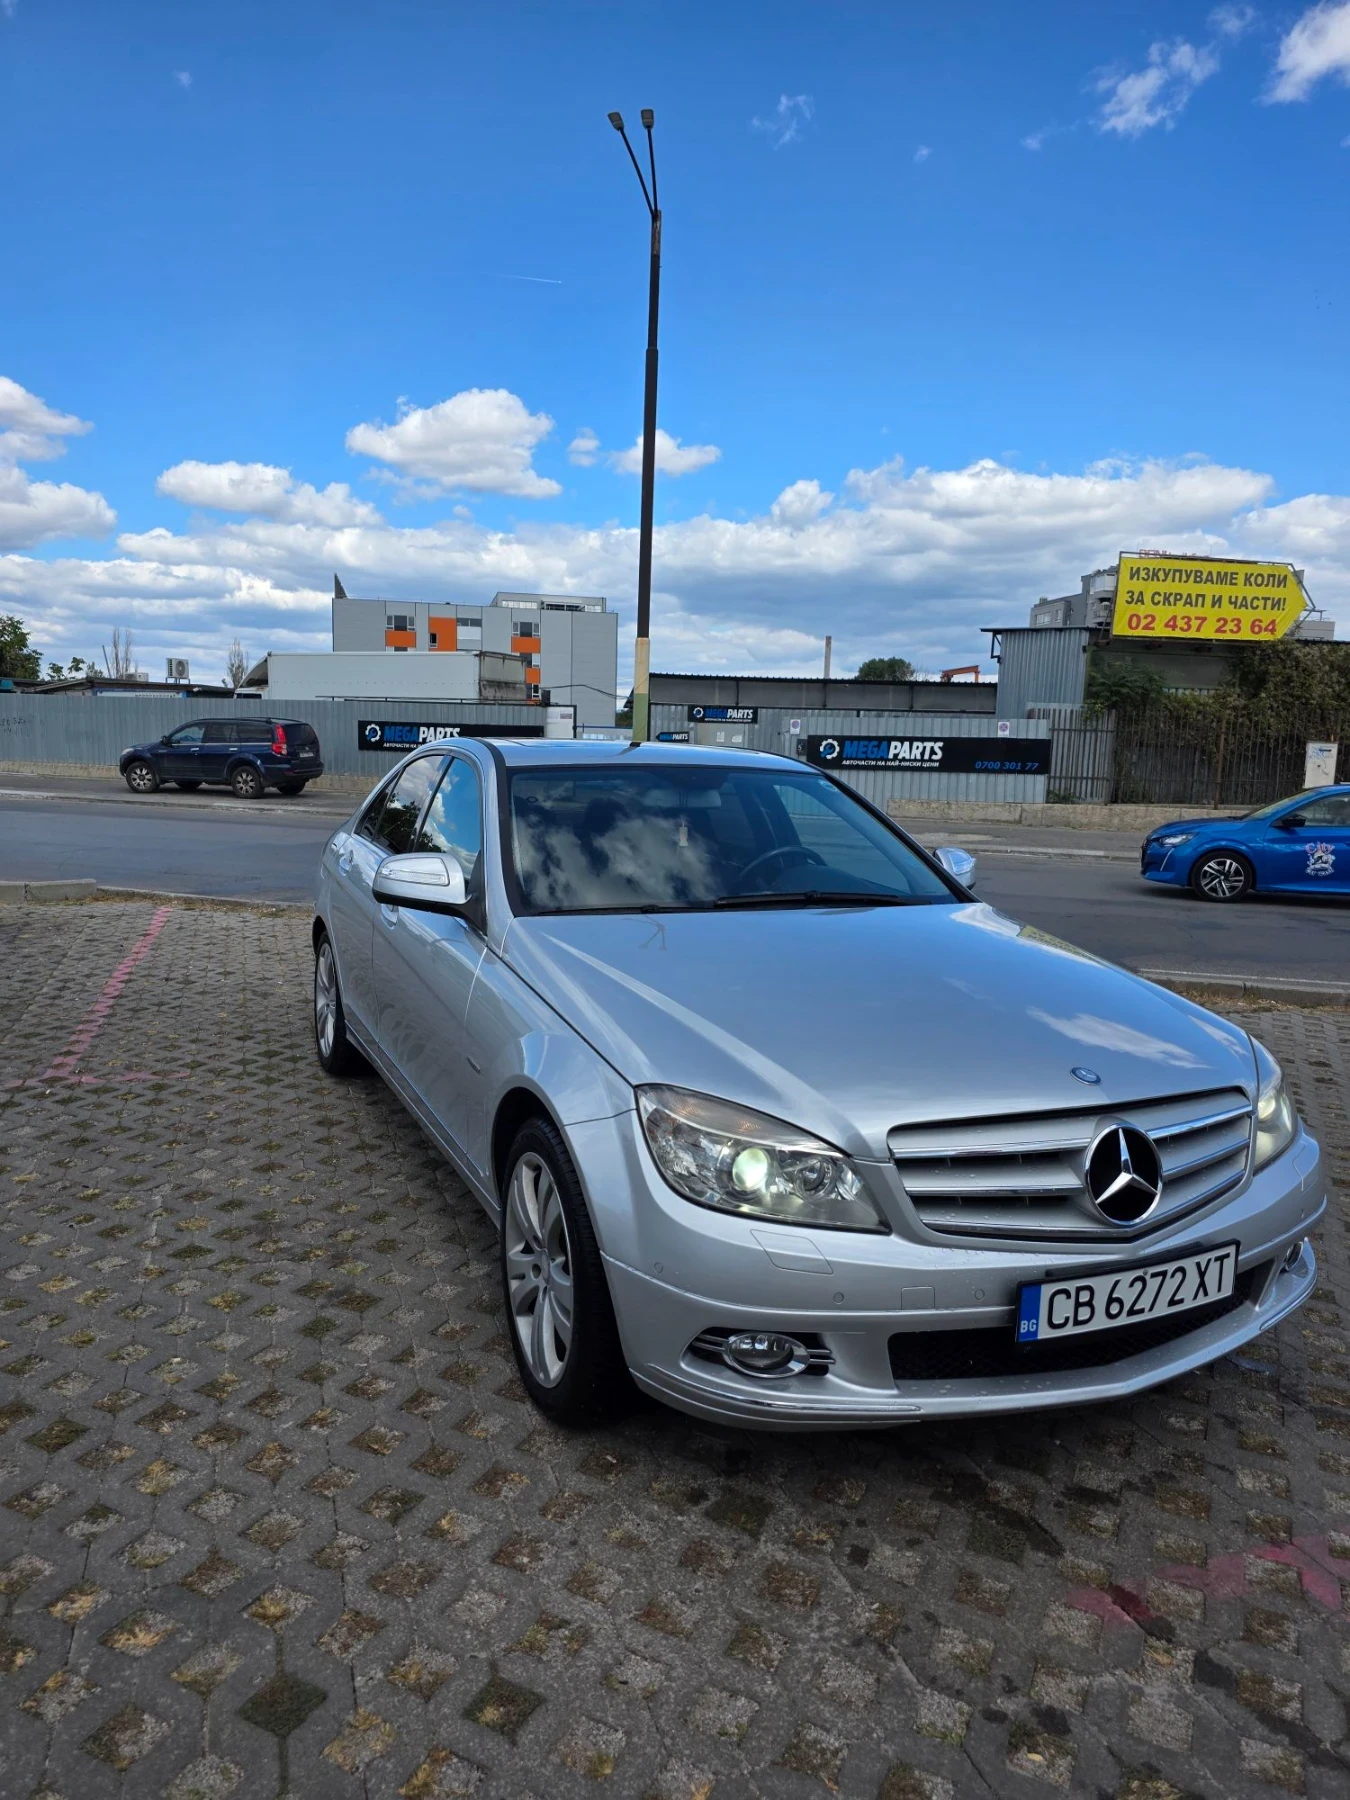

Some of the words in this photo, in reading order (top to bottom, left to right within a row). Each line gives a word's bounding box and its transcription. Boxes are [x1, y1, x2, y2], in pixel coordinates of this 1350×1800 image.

[1129, 566, 1239, 587] ИЗКУПУВАМЕ
[1243, 572, 1288, 589] КОЛИ
[1125, 590, 1145, 606] ЗА
[1150, 591, 1206, 608] СКРАП
[1211, 594, 1223, 609] И
[1228, 595, 1287, 612] ЧАСТИ!
[1127, 613, 1157, 631] 02
[1164, 614, 1208, 633] 437
[1214, 617, 1242, 634] 23
[1250, 618, 1278, 636] 64
[842, 740, 944, 760] MEGAPARTS
[975, 761, 1000, 770] 0700
[1002, 761, 1022, 770] 301
[1025, 762, 1039, 770] 77
[1047, 1284, 1095, 1330] CB
[1104, 1265, 1187, 1320] 6272
[1192, 1252, 1231, 1301] XT
[1020, 1319, 1037, 1333] BG
